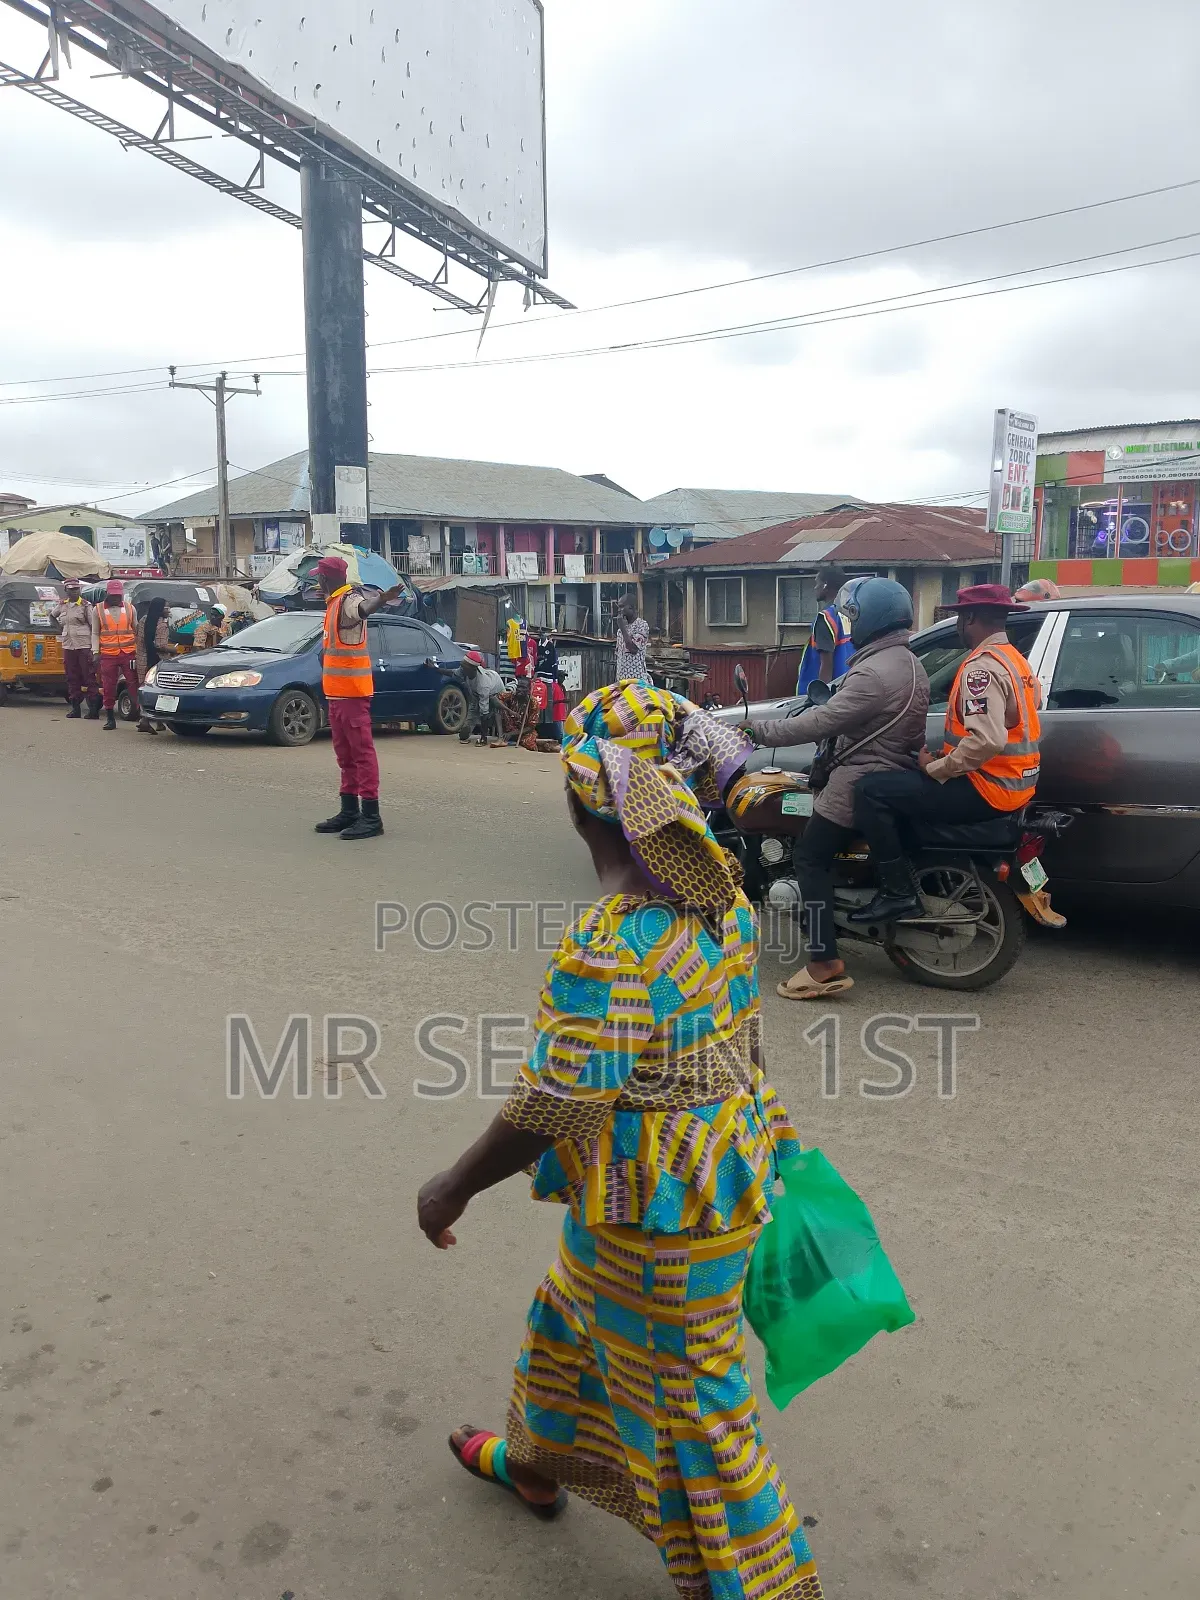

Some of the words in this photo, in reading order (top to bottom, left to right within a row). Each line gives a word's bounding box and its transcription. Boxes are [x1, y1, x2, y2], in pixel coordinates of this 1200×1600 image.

[1007, 432, 1035, 450] GENERAL
[1153, 441, 1194, 453] ELECTRICAL
[1009, 448, 1031, 465] ZOBIC
[1007, 462, 1029, 484] ENT.
[748, 786, 767, 795] TVS
